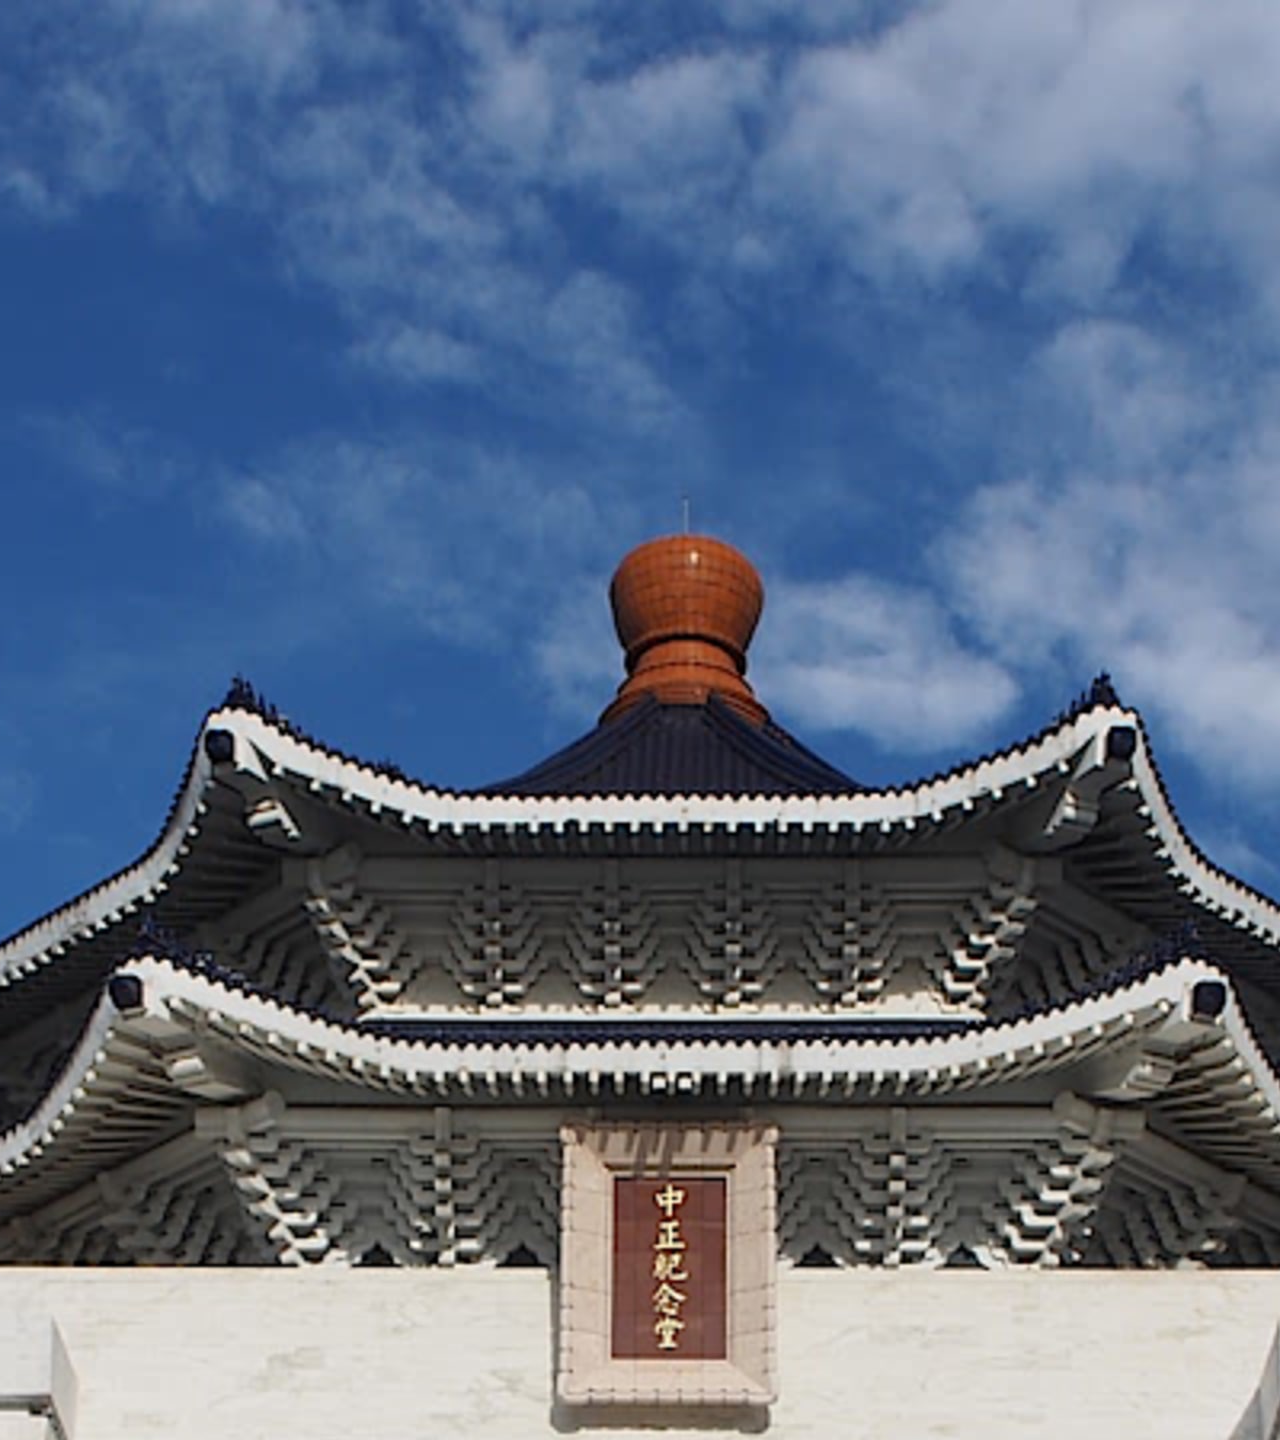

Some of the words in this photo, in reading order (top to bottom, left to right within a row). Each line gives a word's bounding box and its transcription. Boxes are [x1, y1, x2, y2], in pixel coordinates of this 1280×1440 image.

[653, 1183, 689, 1349] 中正紀念堂
